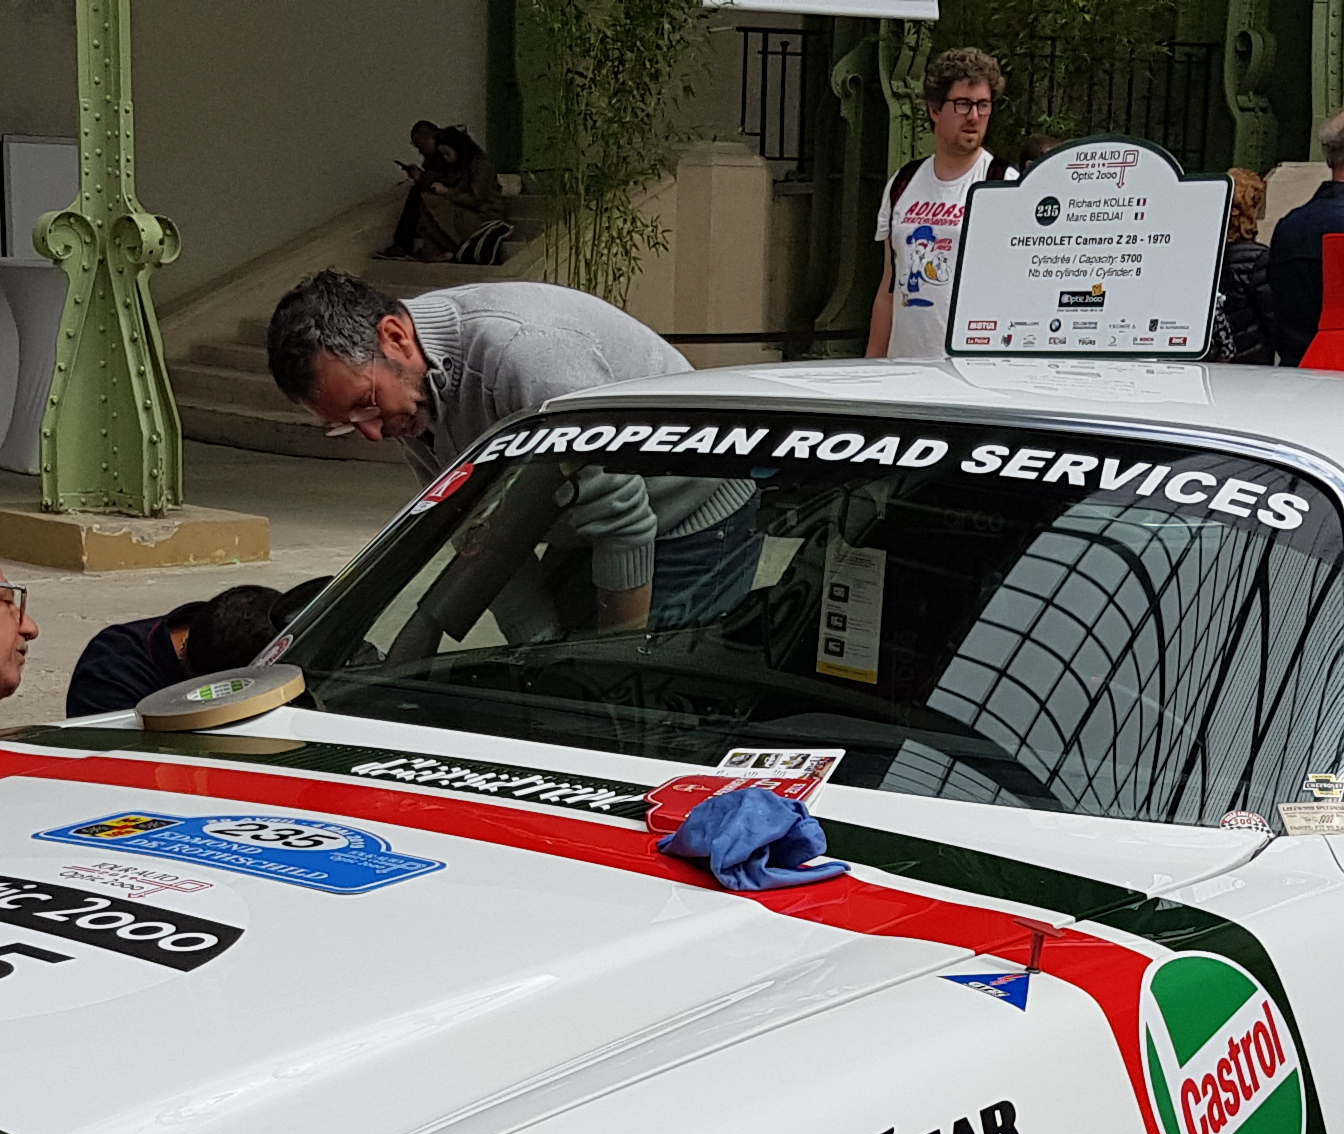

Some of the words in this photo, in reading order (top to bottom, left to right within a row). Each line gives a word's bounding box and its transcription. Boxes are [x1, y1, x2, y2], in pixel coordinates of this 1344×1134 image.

[1075, 151, 1097, 162] TOUR
[1098, 150, 1120, 161] AUTO
[1071, 171, 1094, 183] Optic
[1095, 170, 1118, 180] 2000
[904, 201, 966, 219] ADIDAS
[1068, 198, 1101, 209] Richard
[1102, 197, 1135, 208] KOLLE
[1036, 204, 1059, 218] 235
[1066, 213, 1088, 222] Marc
[1010, 235, 1073, 247] CHEVROLET
[1075, 235, 1114, 246] Camaro
[1115, 234, 1124, 245] Z
[1124, 234, 1138, 245] 28
[1147, 233, 1172, 245] 1970
[1119, 253, 1143, 264] 5700
[969, 322, 996, 330] MOTUL
[473, 424, 772, 465] EUROPEAN
[771, 431, 949, 470] ROAD
[958, 442, 1311, 531] SERVICES
[208, 822, 341, 849] 235
[150, 830, 264, 856] EDMOND
[122, 838, 166, 849] DE
[159, 843, 330, 881] ROTHSCHILD
[33, 896, 230, 955] 2000
